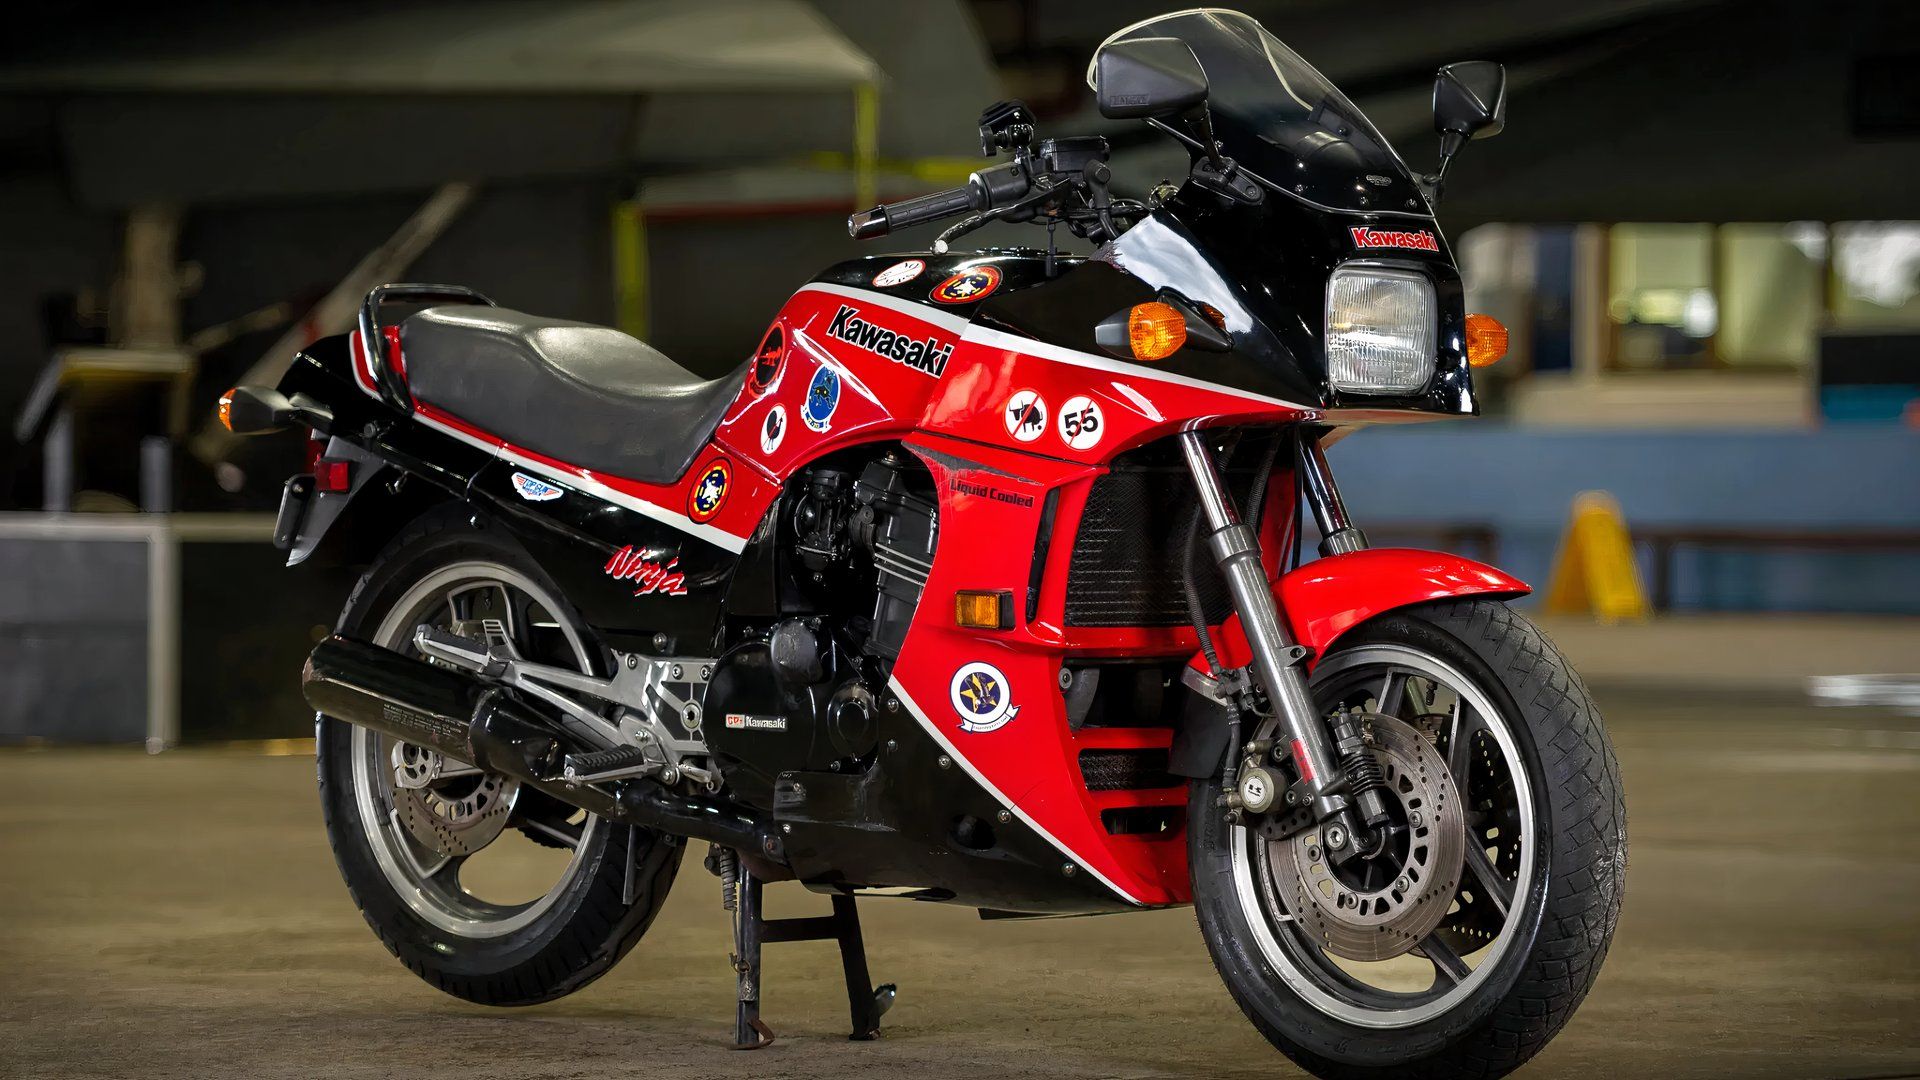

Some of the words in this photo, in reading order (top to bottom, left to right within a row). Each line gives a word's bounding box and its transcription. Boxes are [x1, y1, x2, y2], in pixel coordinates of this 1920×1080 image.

[1351, 226, 1439, 252] Kawasaki
[826, 304, 955, 379] Kawasaki
[1064, 408, 1098, 437] 55
[950, 478, 989, 498] Liquid
[989, 487, 1034, 508] Cooled
[604, 544, 688, 597] Ninja
[745, 715, 786, 729] Kawasaki
